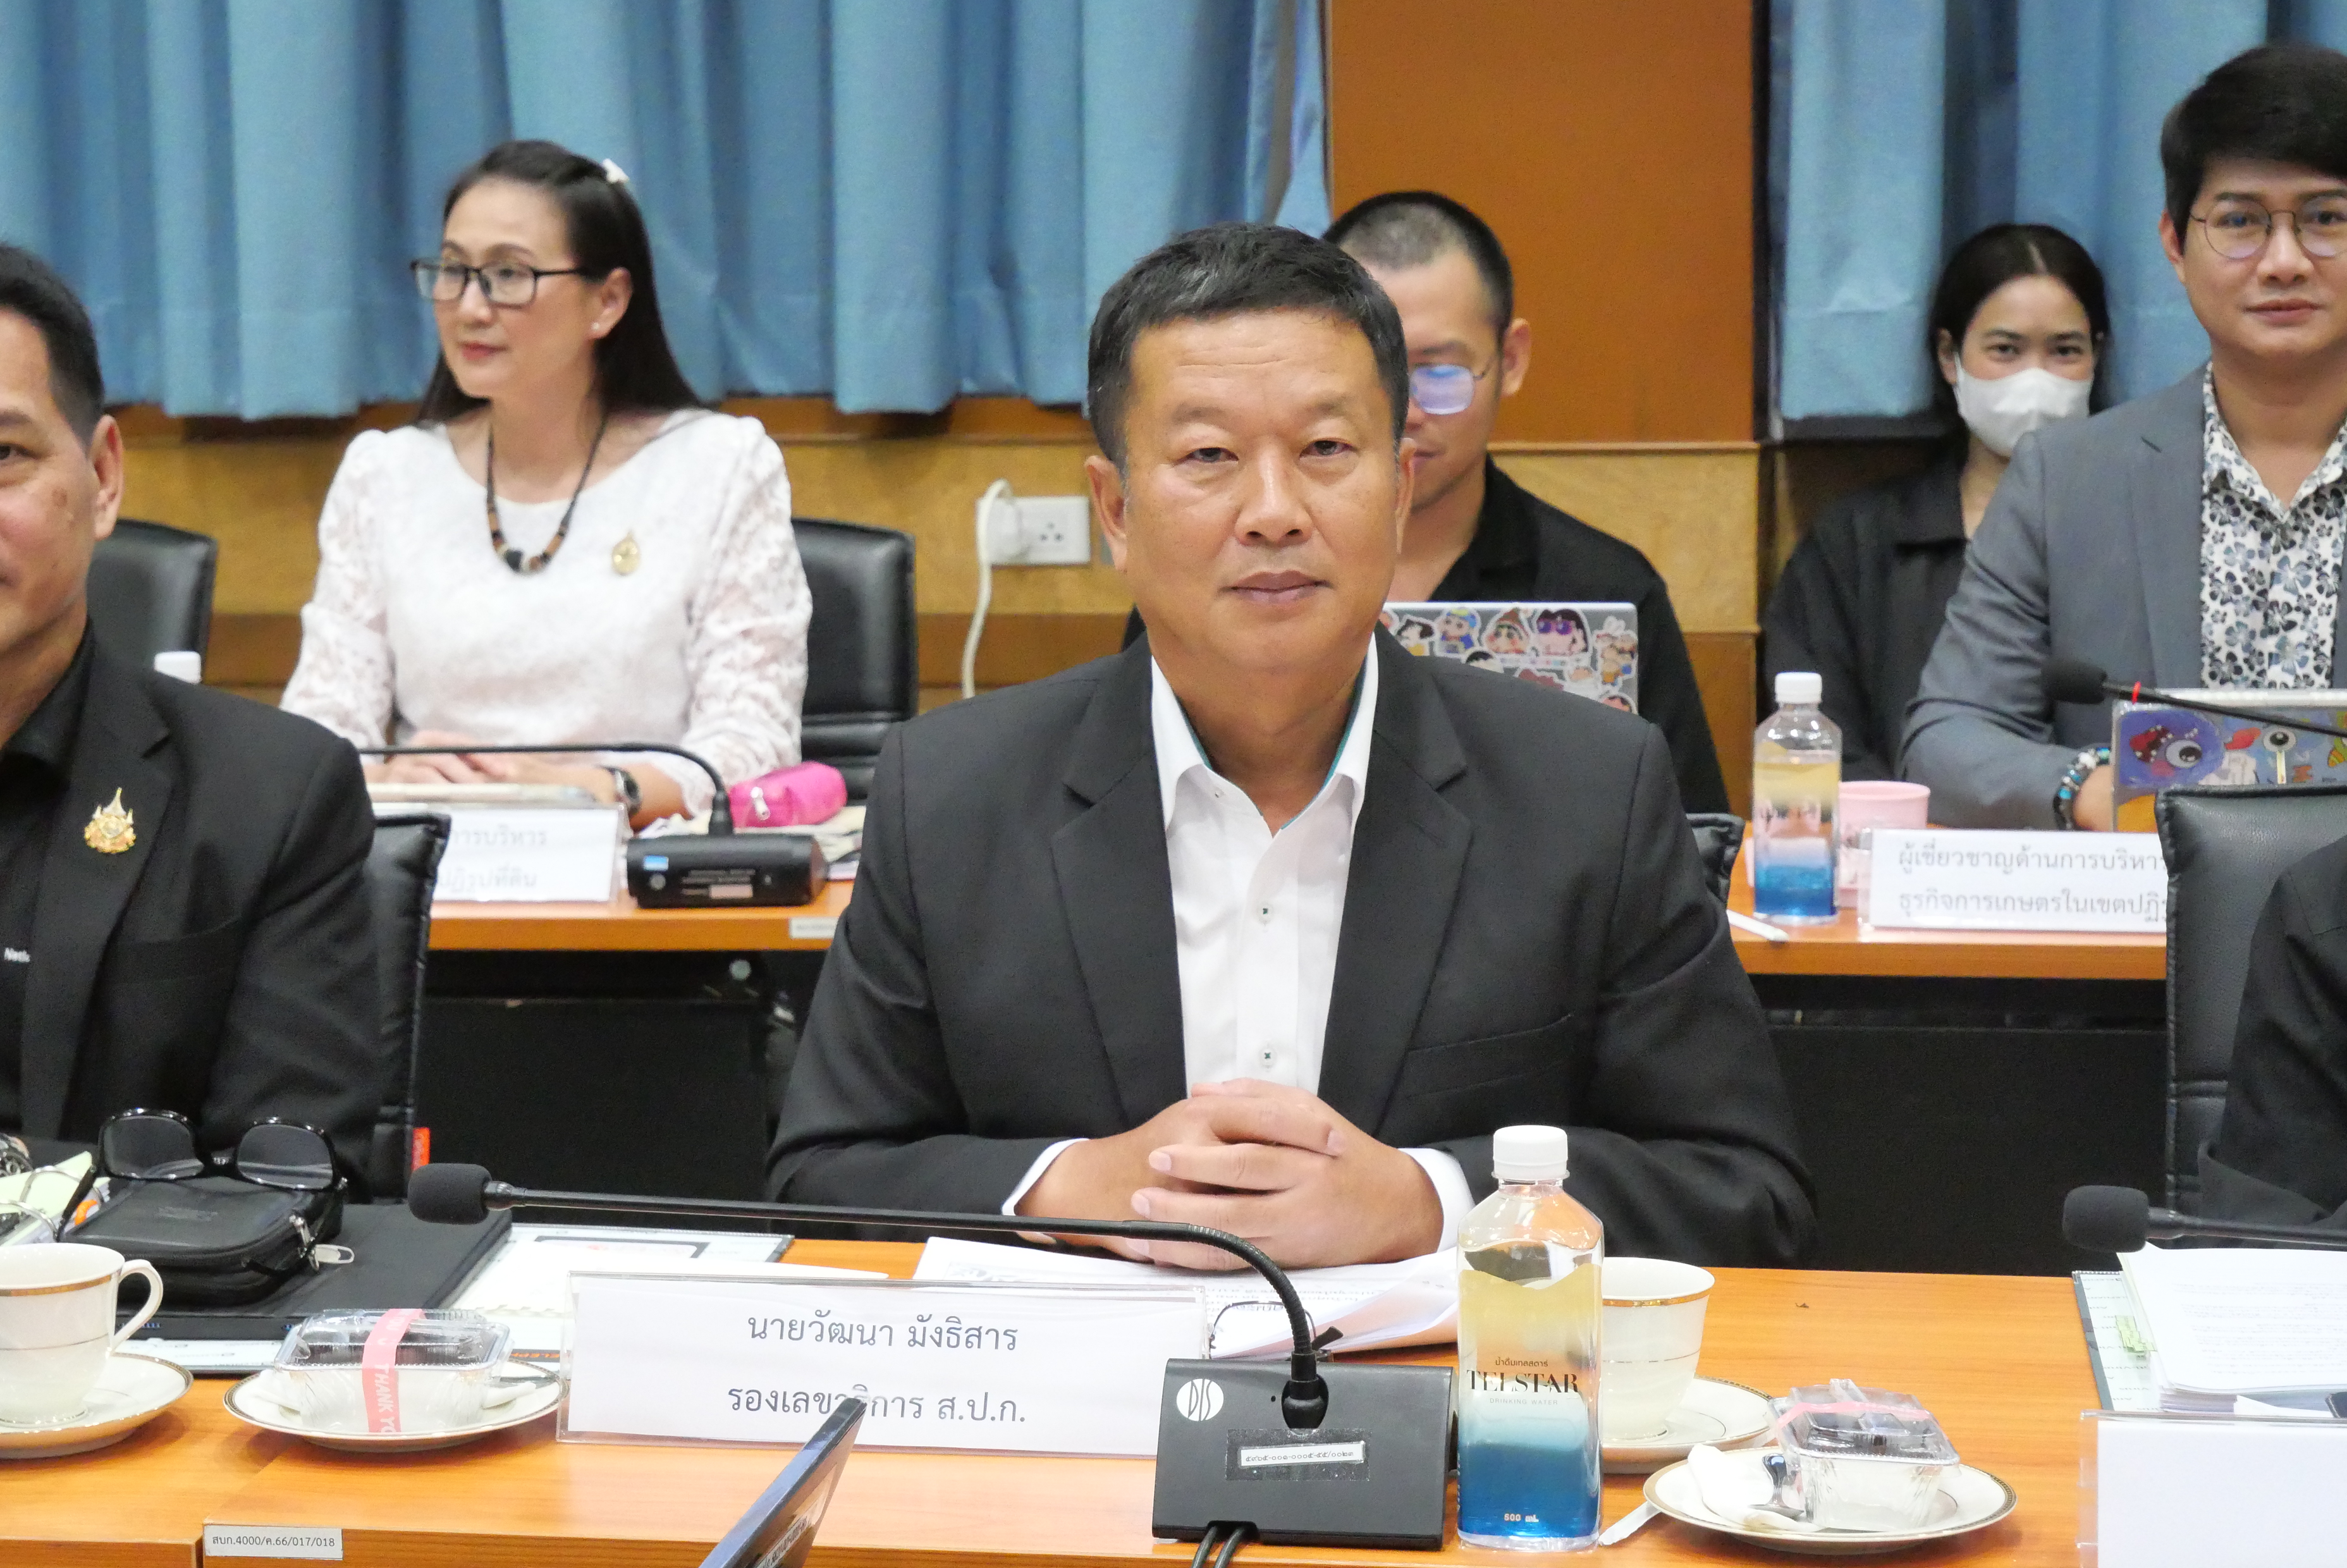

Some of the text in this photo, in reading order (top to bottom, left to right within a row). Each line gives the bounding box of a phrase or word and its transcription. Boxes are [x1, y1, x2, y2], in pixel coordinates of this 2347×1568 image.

[747, 1309, 1019, 1351] นายวัฒนา มังธิสาร
[374, 1363, 394, 1412] THANK
[1466, 1369, 1581, 1393] TELSTAR
[937, 1392, 1026, 1423] ส.ป.ก.
[1504, 1513, 1522, 1521] 500
